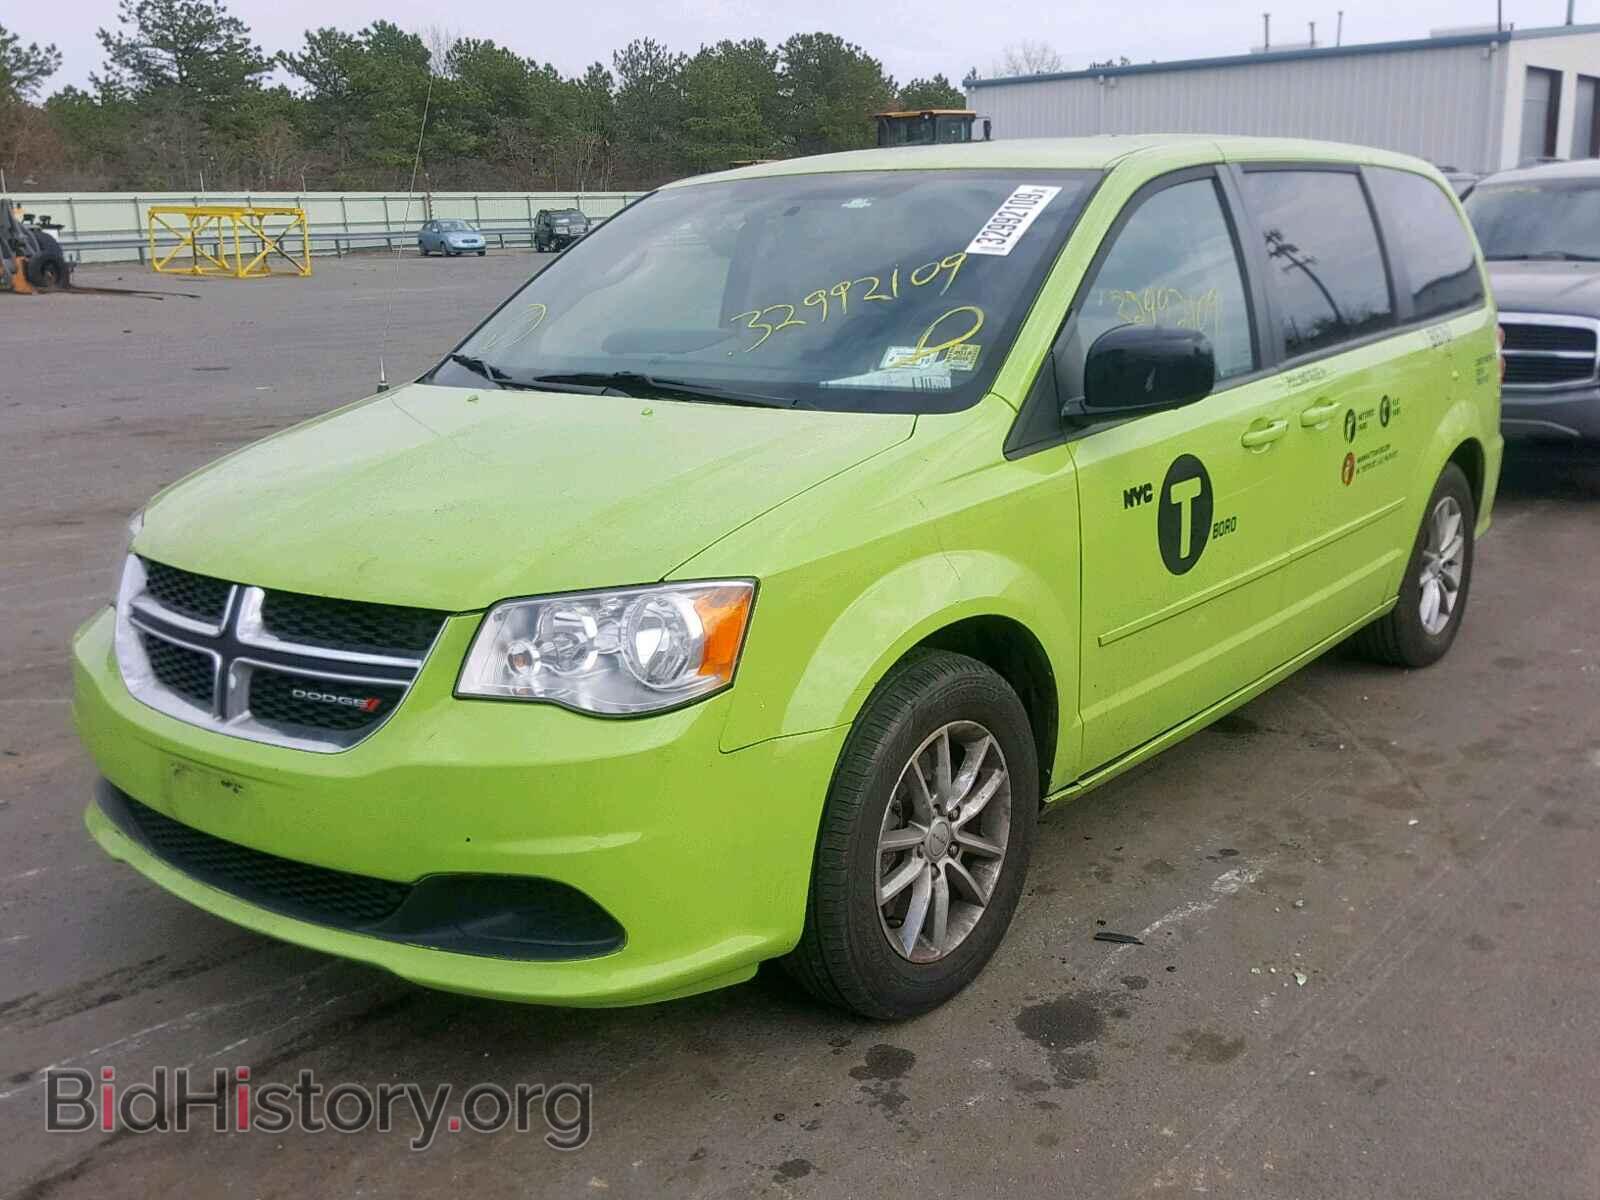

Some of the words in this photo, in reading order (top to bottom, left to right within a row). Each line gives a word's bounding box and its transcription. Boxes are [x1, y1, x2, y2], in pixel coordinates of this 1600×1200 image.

[975, 193, 1045, 245] 32992109
[730, 252, 968, 353] 32992109
[1123, 483, 1153, 510] NYC
[1212, 516, 1238, 540] BORO
[292, 689, 369, 710] DODGE
